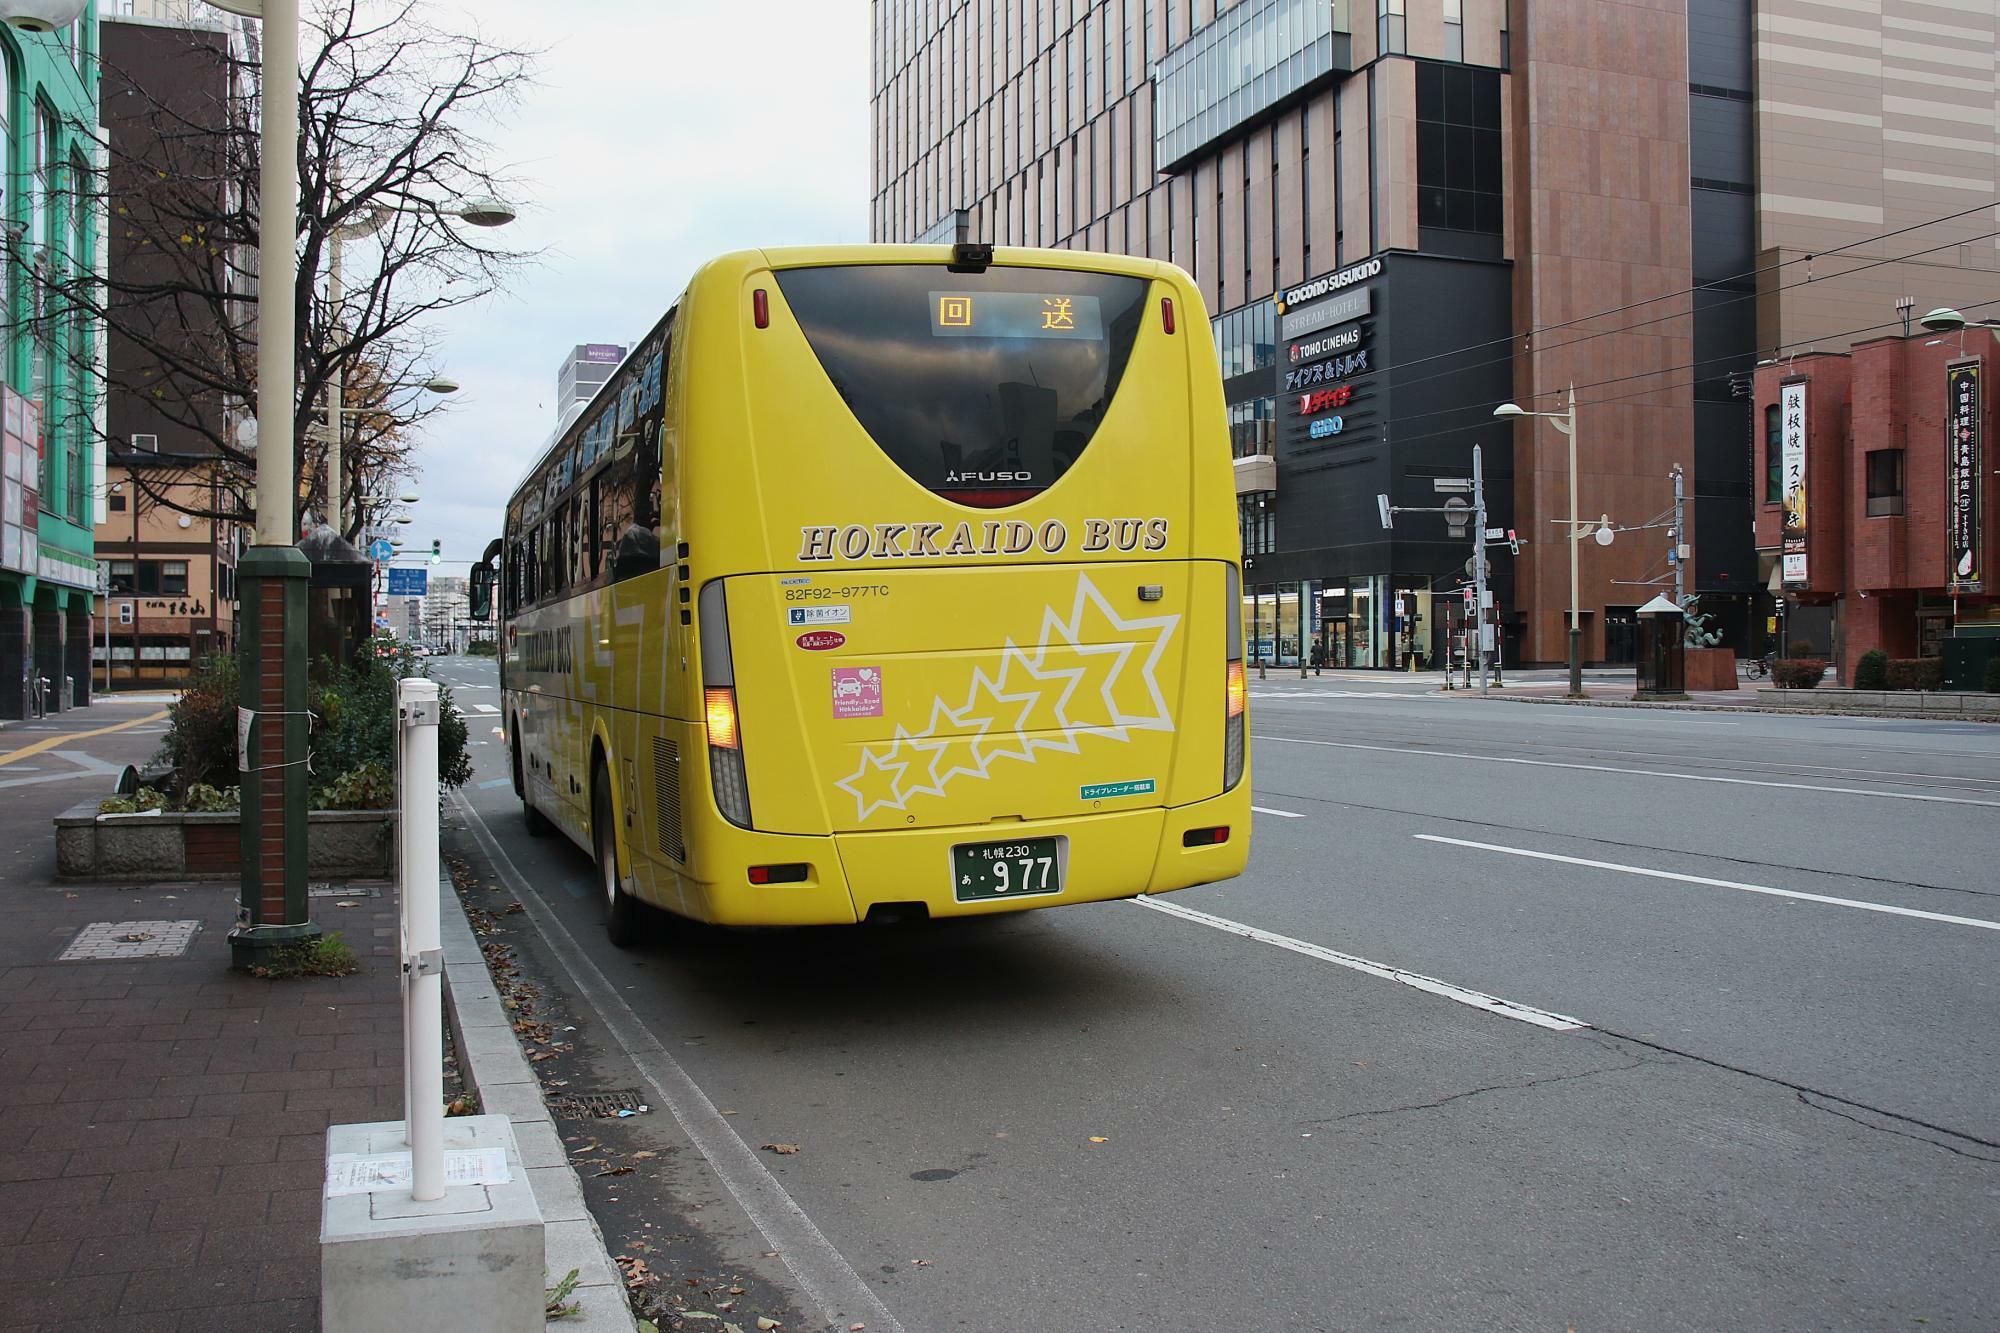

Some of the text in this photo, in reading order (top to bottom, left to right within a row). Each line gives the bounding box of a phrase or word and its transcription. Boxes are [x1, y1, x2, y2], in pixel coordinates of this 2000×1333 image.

[939, 297, 1074, 329] 回 送
[1329, 297, 1360, 319] HOTEL
[1299, 328, 1359, 359] TOHO CINEMAS
[961, 471, 1032, 481] FUSO
[1788, 464, 1801, 528] ステーキ
[798, 518, 1169, 561] HOKKAIDO BUS
[785, 585, 889, 600] 82F92-977TC
[982, 845, 1030, 860] 札幌230
[961, 875, 972, 886] あ
